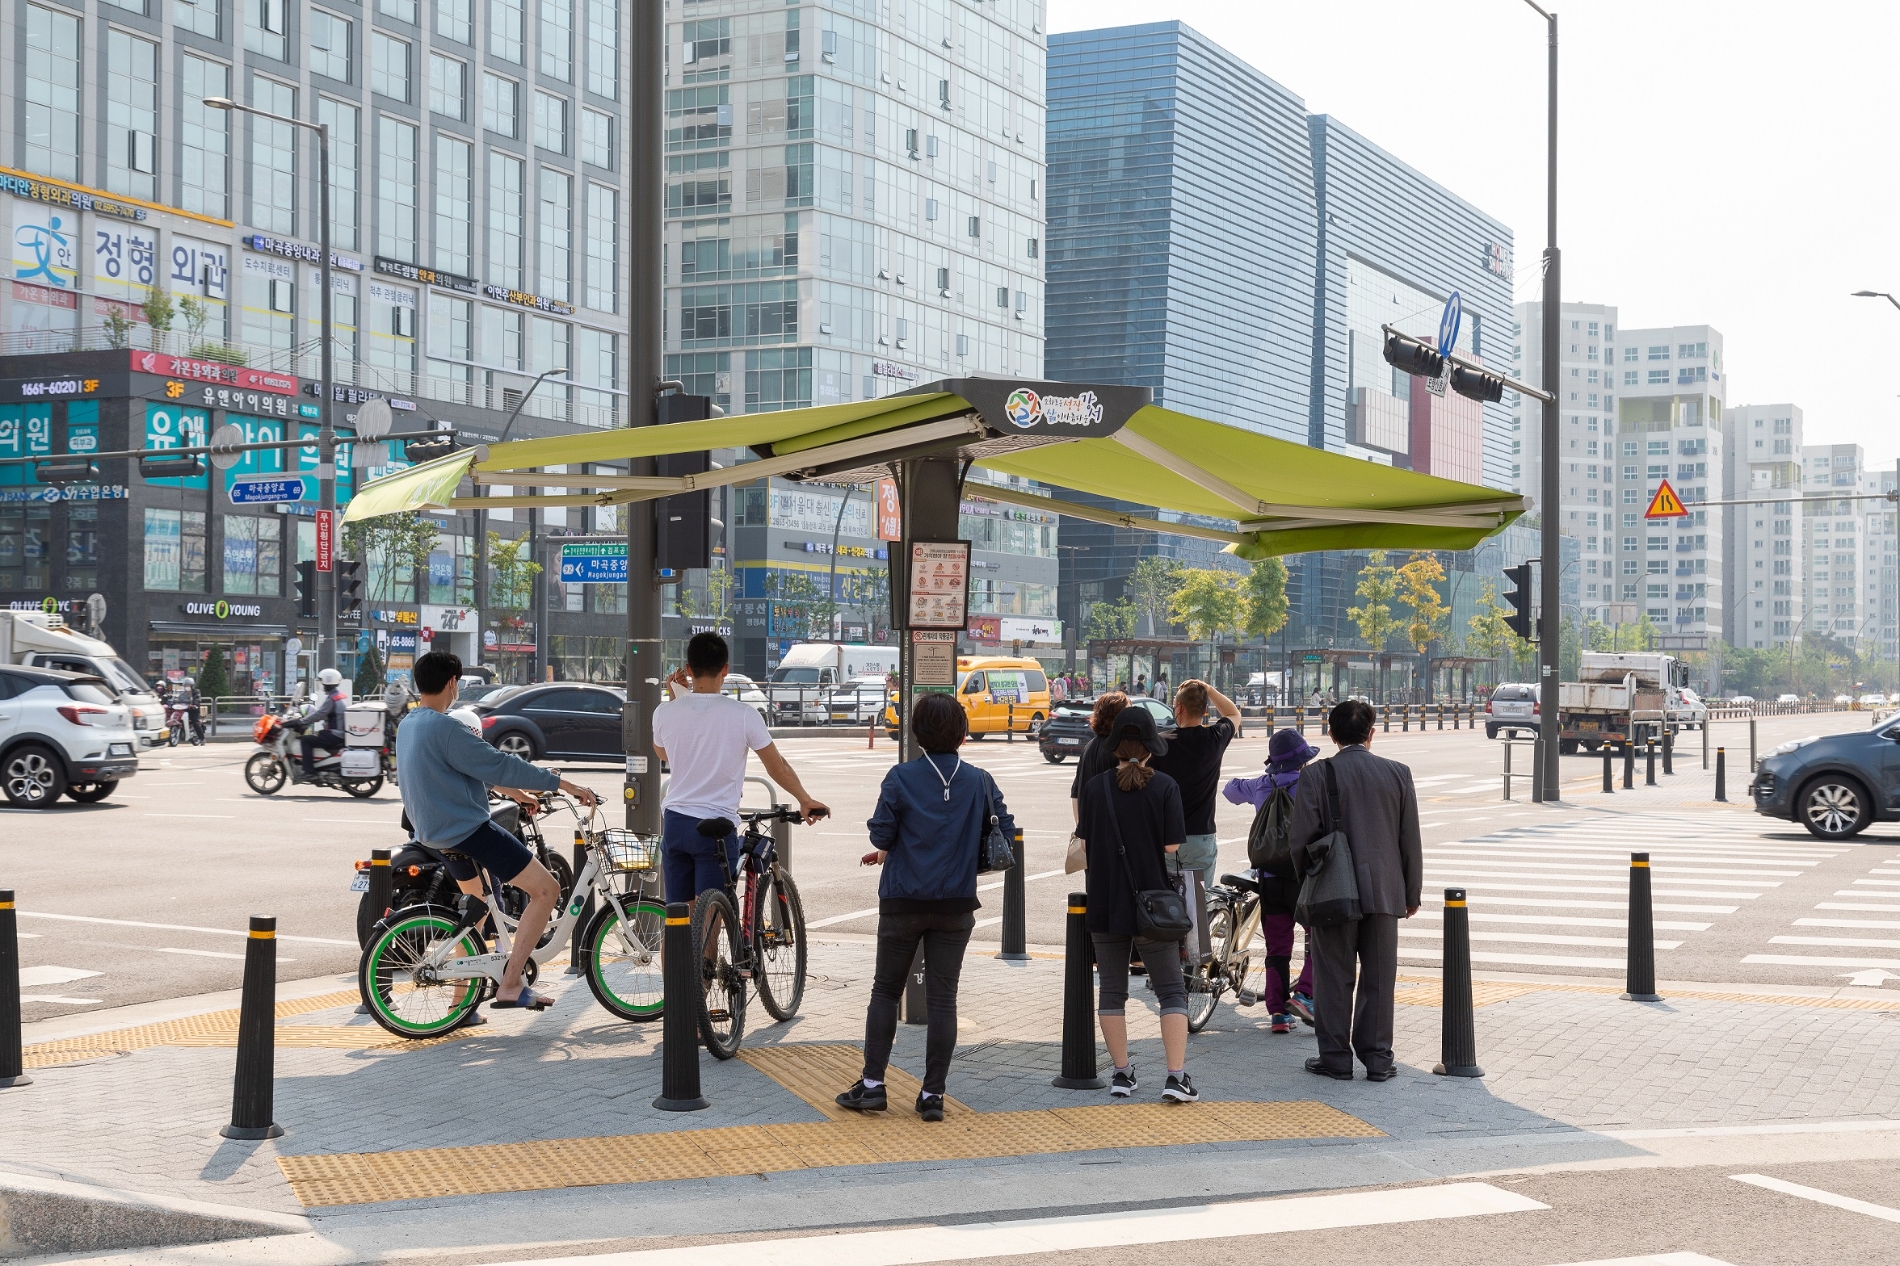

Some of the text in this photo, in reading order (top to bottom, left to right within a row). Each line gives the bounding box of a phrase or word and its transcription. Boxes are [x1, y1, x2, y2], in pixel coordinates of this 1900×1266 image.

[57, 248, 71, 269] 안
[96, 231, 227, 293] 정형 외과
[22, 379, 100, 396] 1661-6020 3F
[165, 381, 287, 416] 3F 유앤아이의원
[249, 482, 285, 493] 마곡중앙로
[320, 512, 329, 569] 무단횡단금지
[607, 546, 626, 555] 김포공
[591, 559, 627, 571] 마곡중앙
[587, 571, 627, 580] Magokjungan
[10, 601, 42, 611] OLIVE
[187, 603, 261, 616] OLIVE YOUNG
[441, 613, 460, 630] 747
